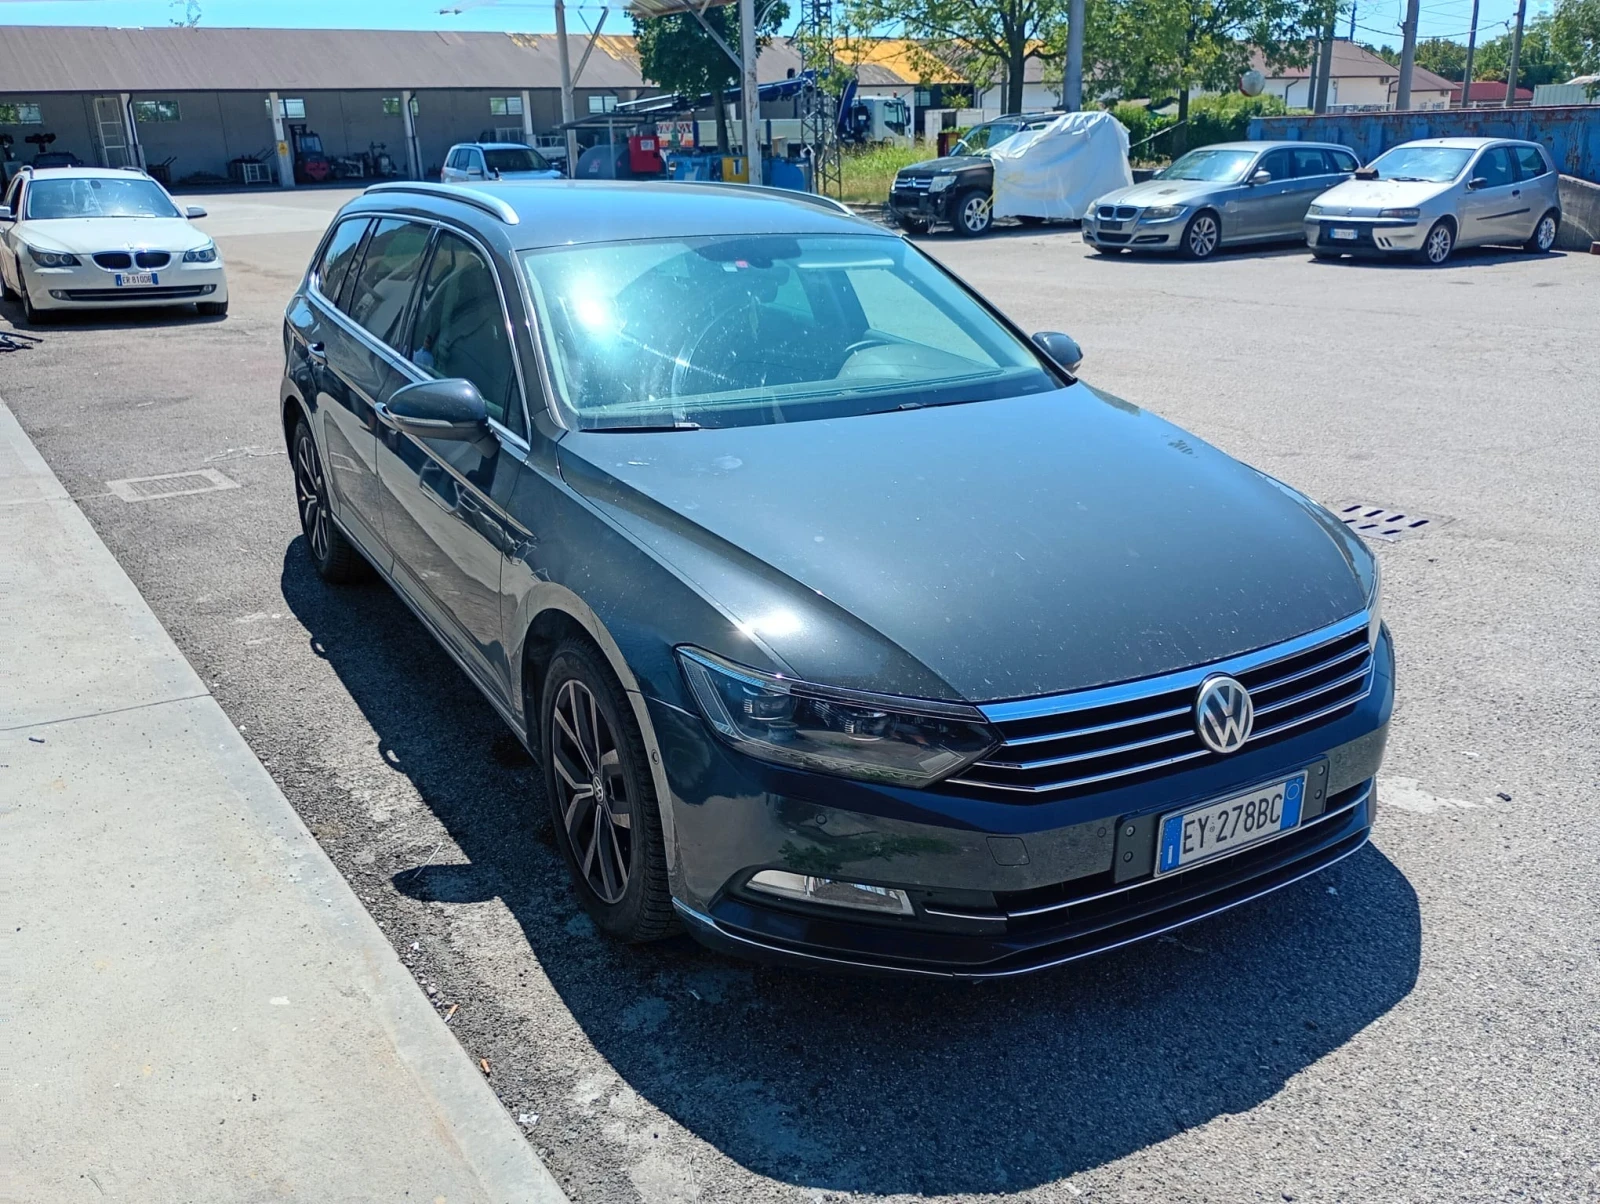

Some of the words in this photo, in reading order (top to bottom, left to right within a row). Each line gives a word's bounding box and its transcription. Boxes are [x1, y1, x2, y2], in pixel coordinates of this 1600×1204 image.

[1198, 679, 1251, 751] VW
[1167, 844, 1174, 865] I
[1182, 815, 1210, 855] EY
[1215, 793, 1283, 843] 278BC
